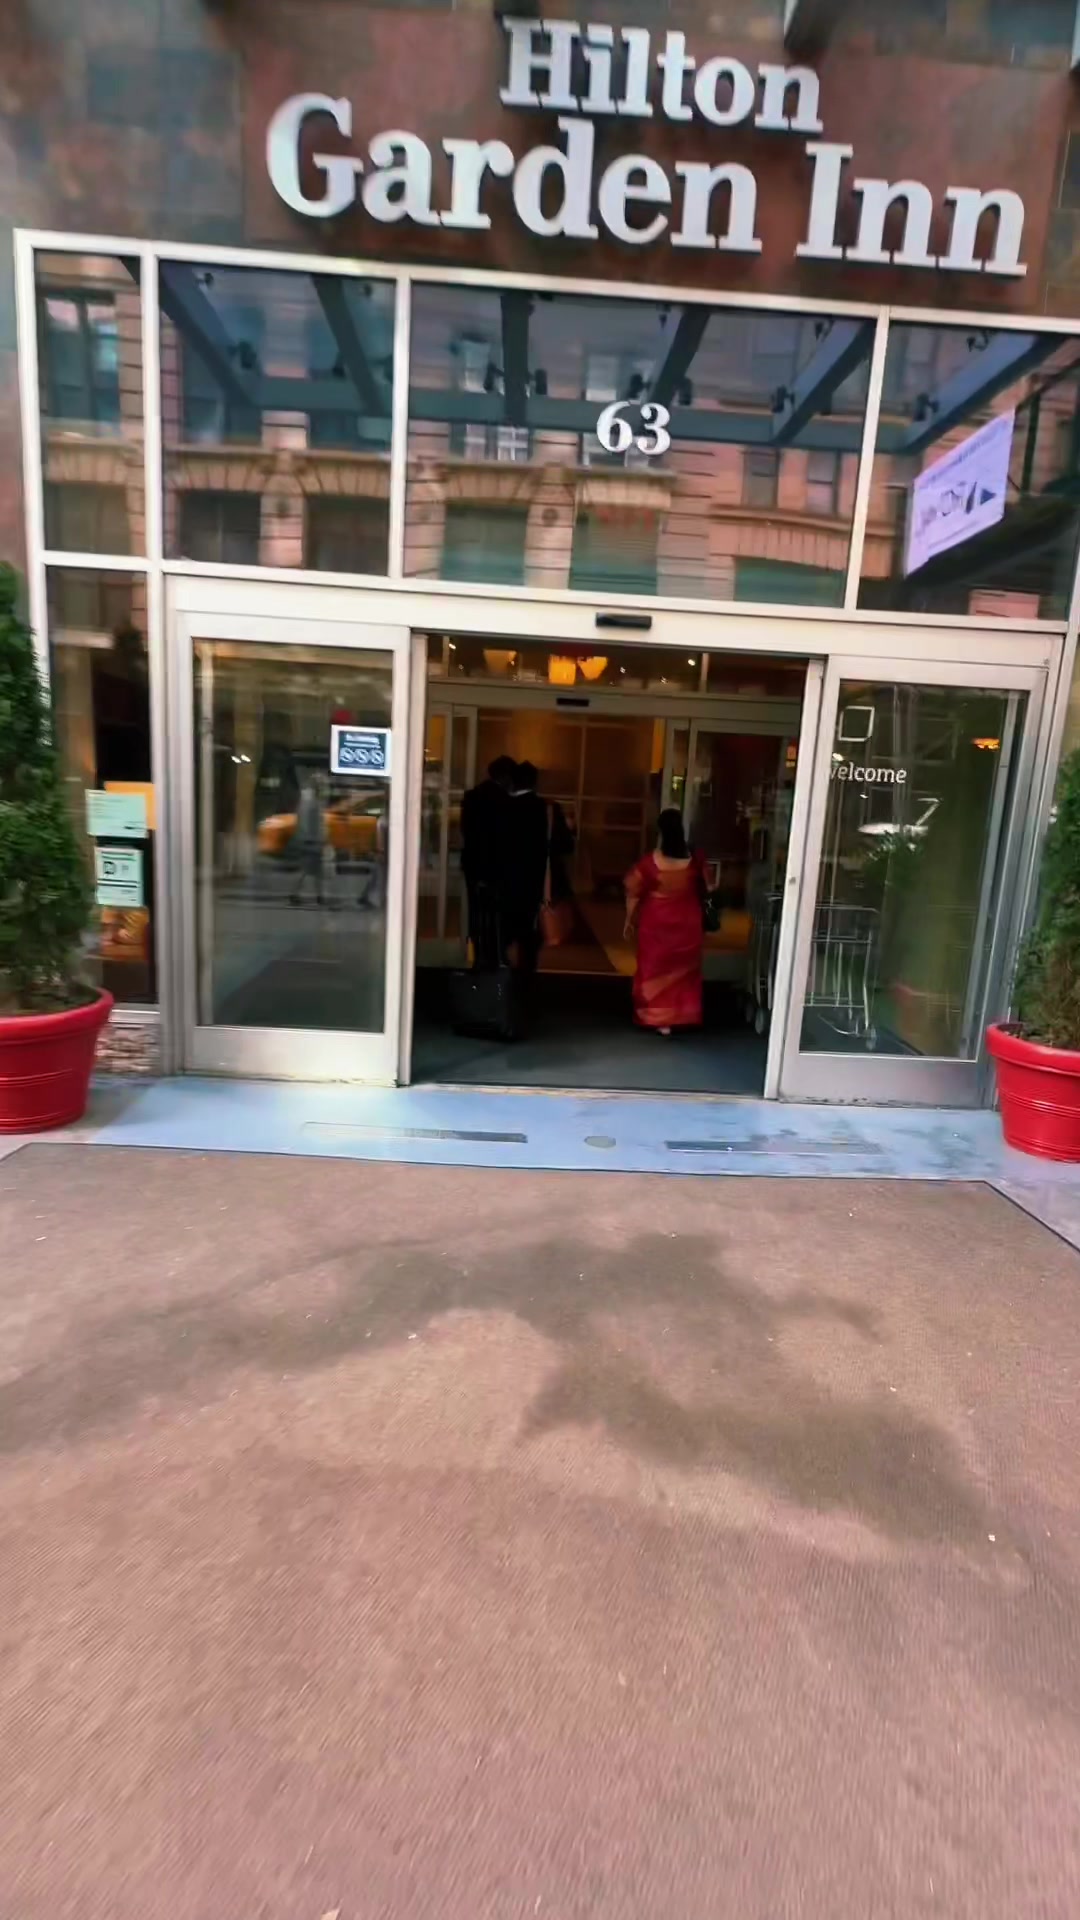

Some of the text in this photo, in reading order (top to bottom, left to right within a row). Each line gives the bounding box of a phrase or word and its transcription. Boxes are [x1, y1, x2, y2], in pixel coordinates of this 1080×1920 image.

[499, 16, 823, 133] Hilton
[266, 92, 1027, 275] Garden Inn
[596, 401, 671, 455] 63
